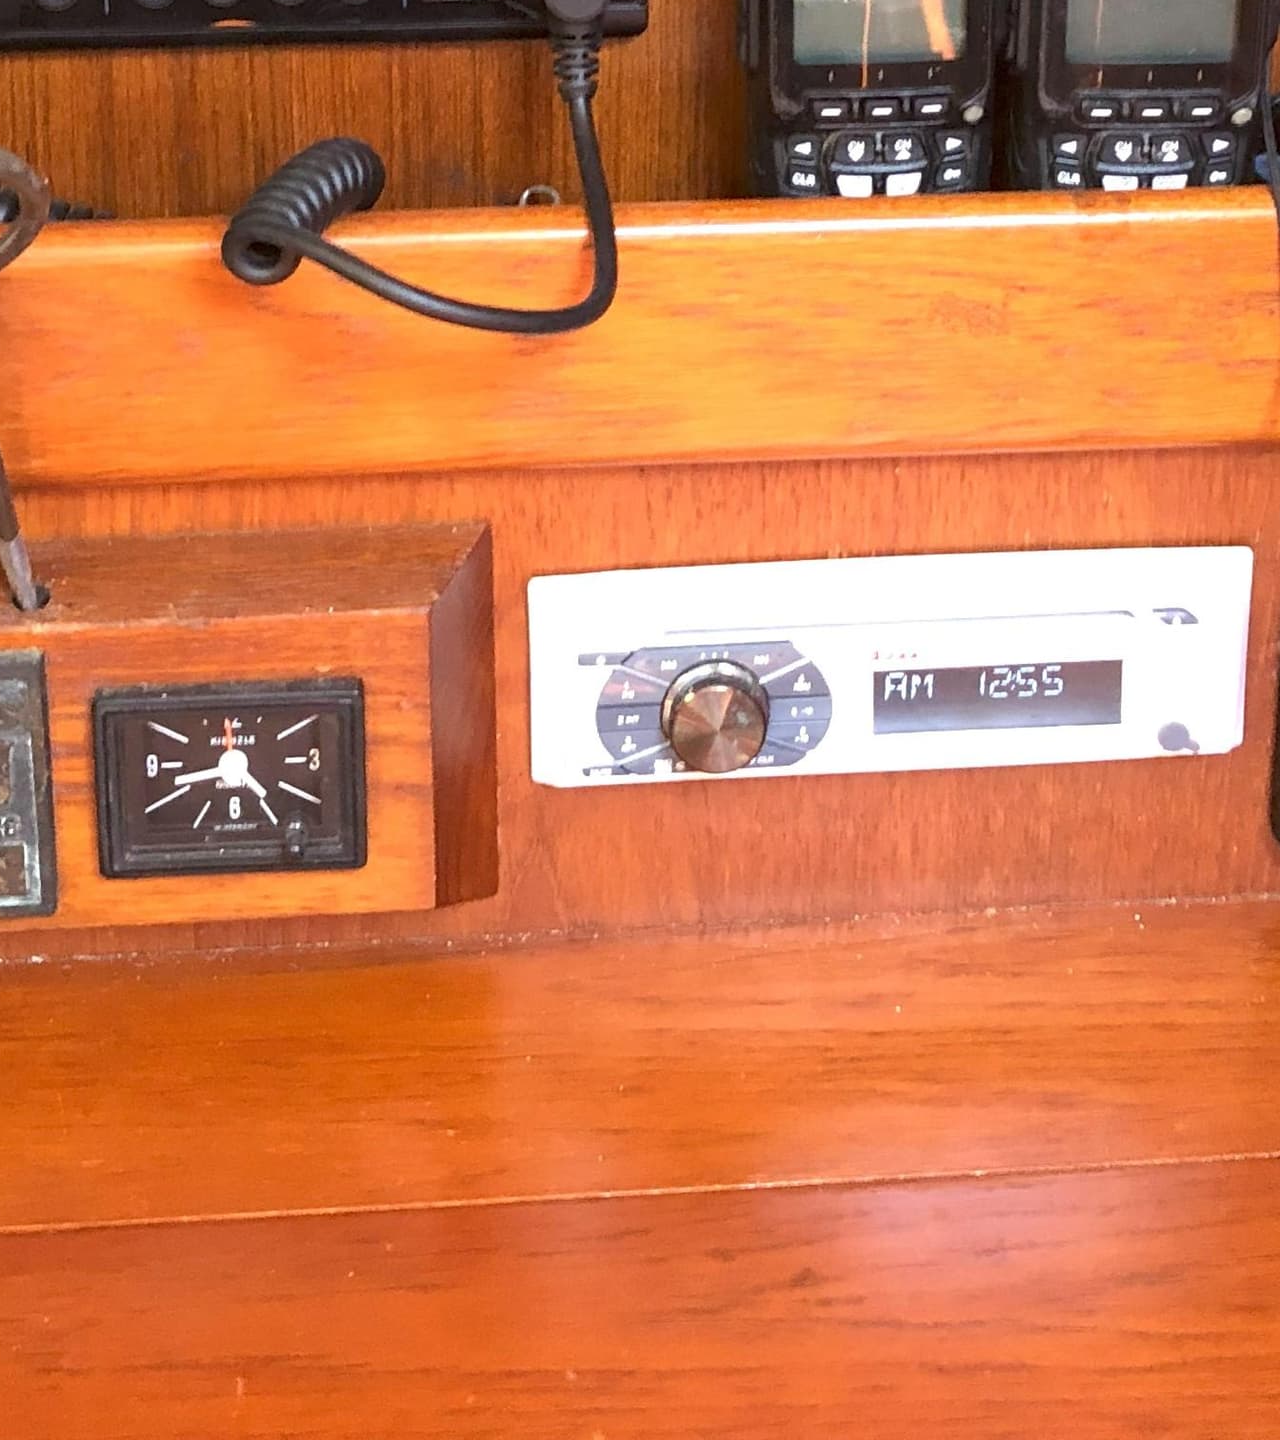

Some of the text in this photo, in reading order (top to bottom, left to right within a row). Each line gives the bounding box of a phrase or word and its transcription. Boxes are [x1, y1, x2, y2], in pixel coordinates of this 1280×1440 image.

[884, 664, 1065, 701] AM 12:55
[145, 754, 159, 778] 9
[308, 747, 321, 771] 3
[228, 795, 242, 820] 6
